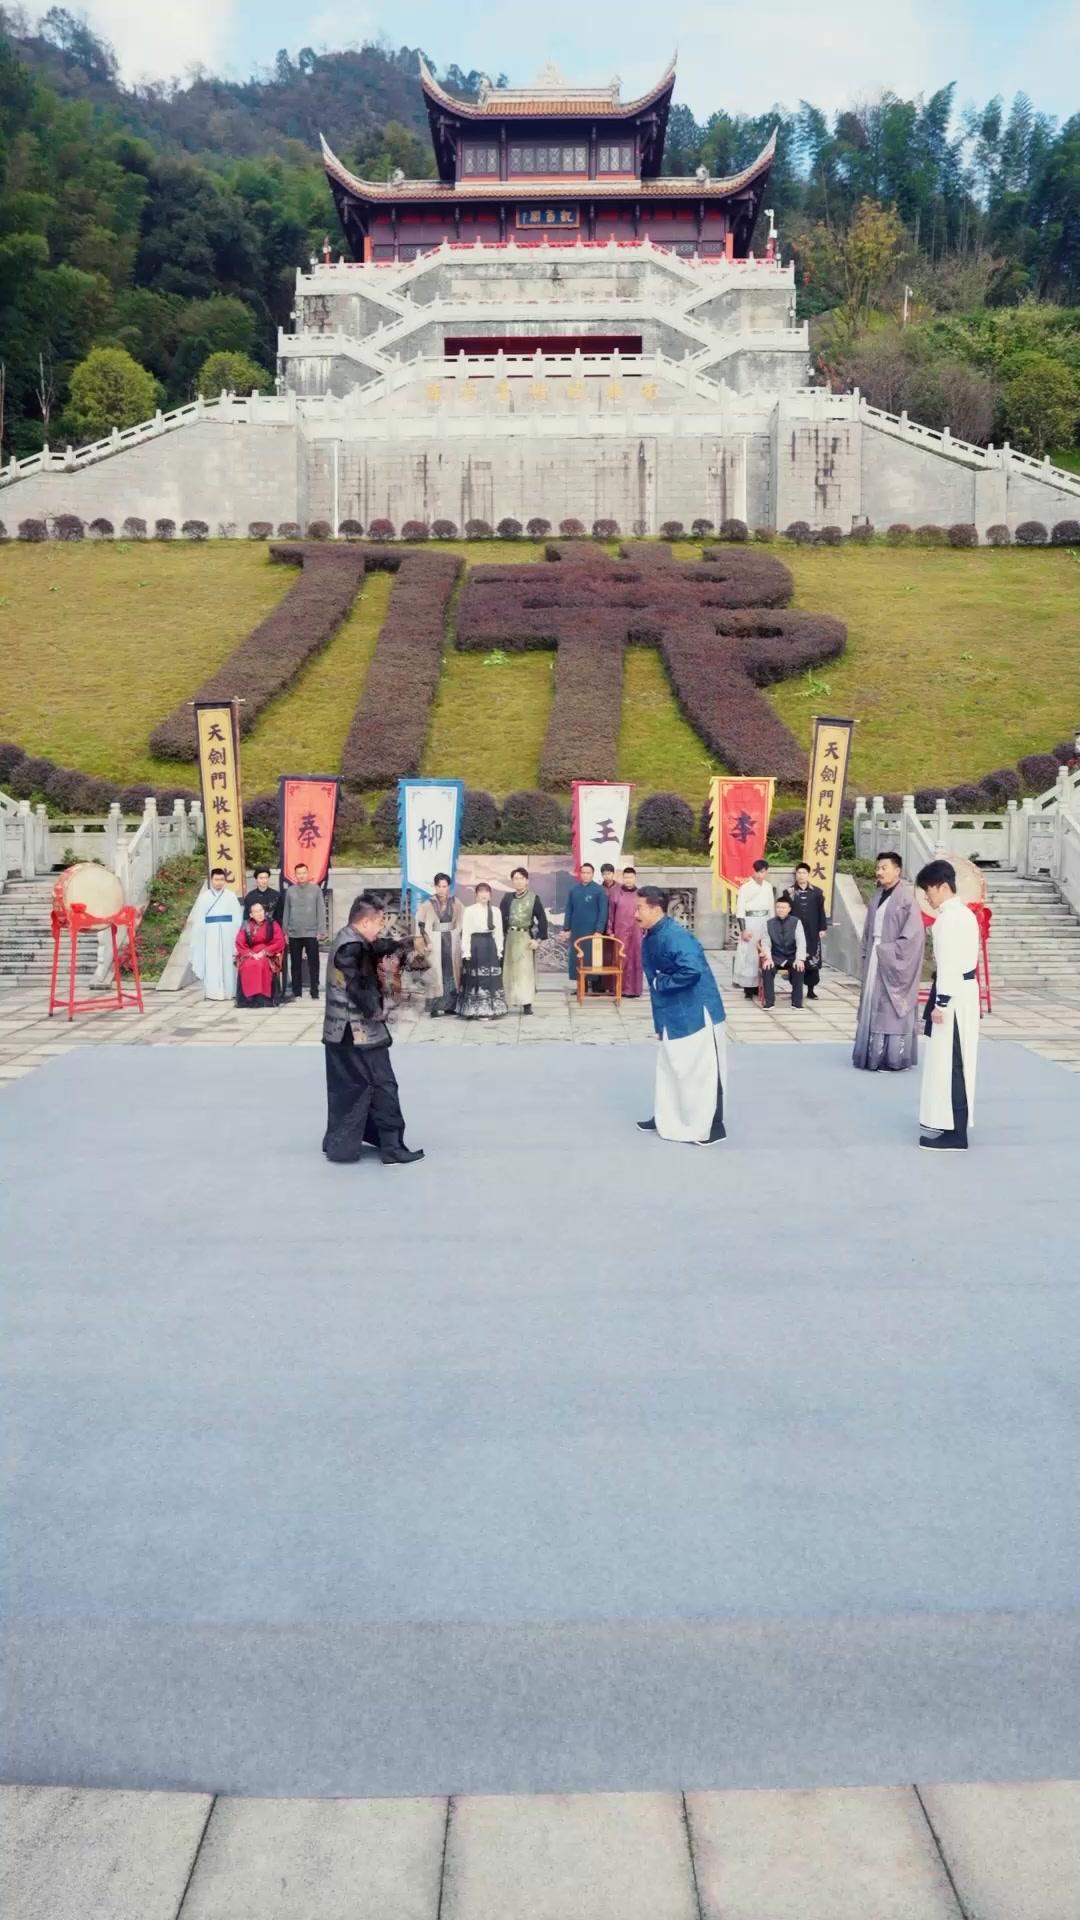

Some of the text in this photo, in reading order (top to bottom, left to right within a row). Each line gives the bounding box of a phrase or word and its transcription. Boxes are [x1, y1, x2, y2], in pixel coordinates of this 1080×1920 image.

[297, 811, 323, 848] 秦
[417, 818, 443, 851] 柳
[591, 818, 620, 845] 王
